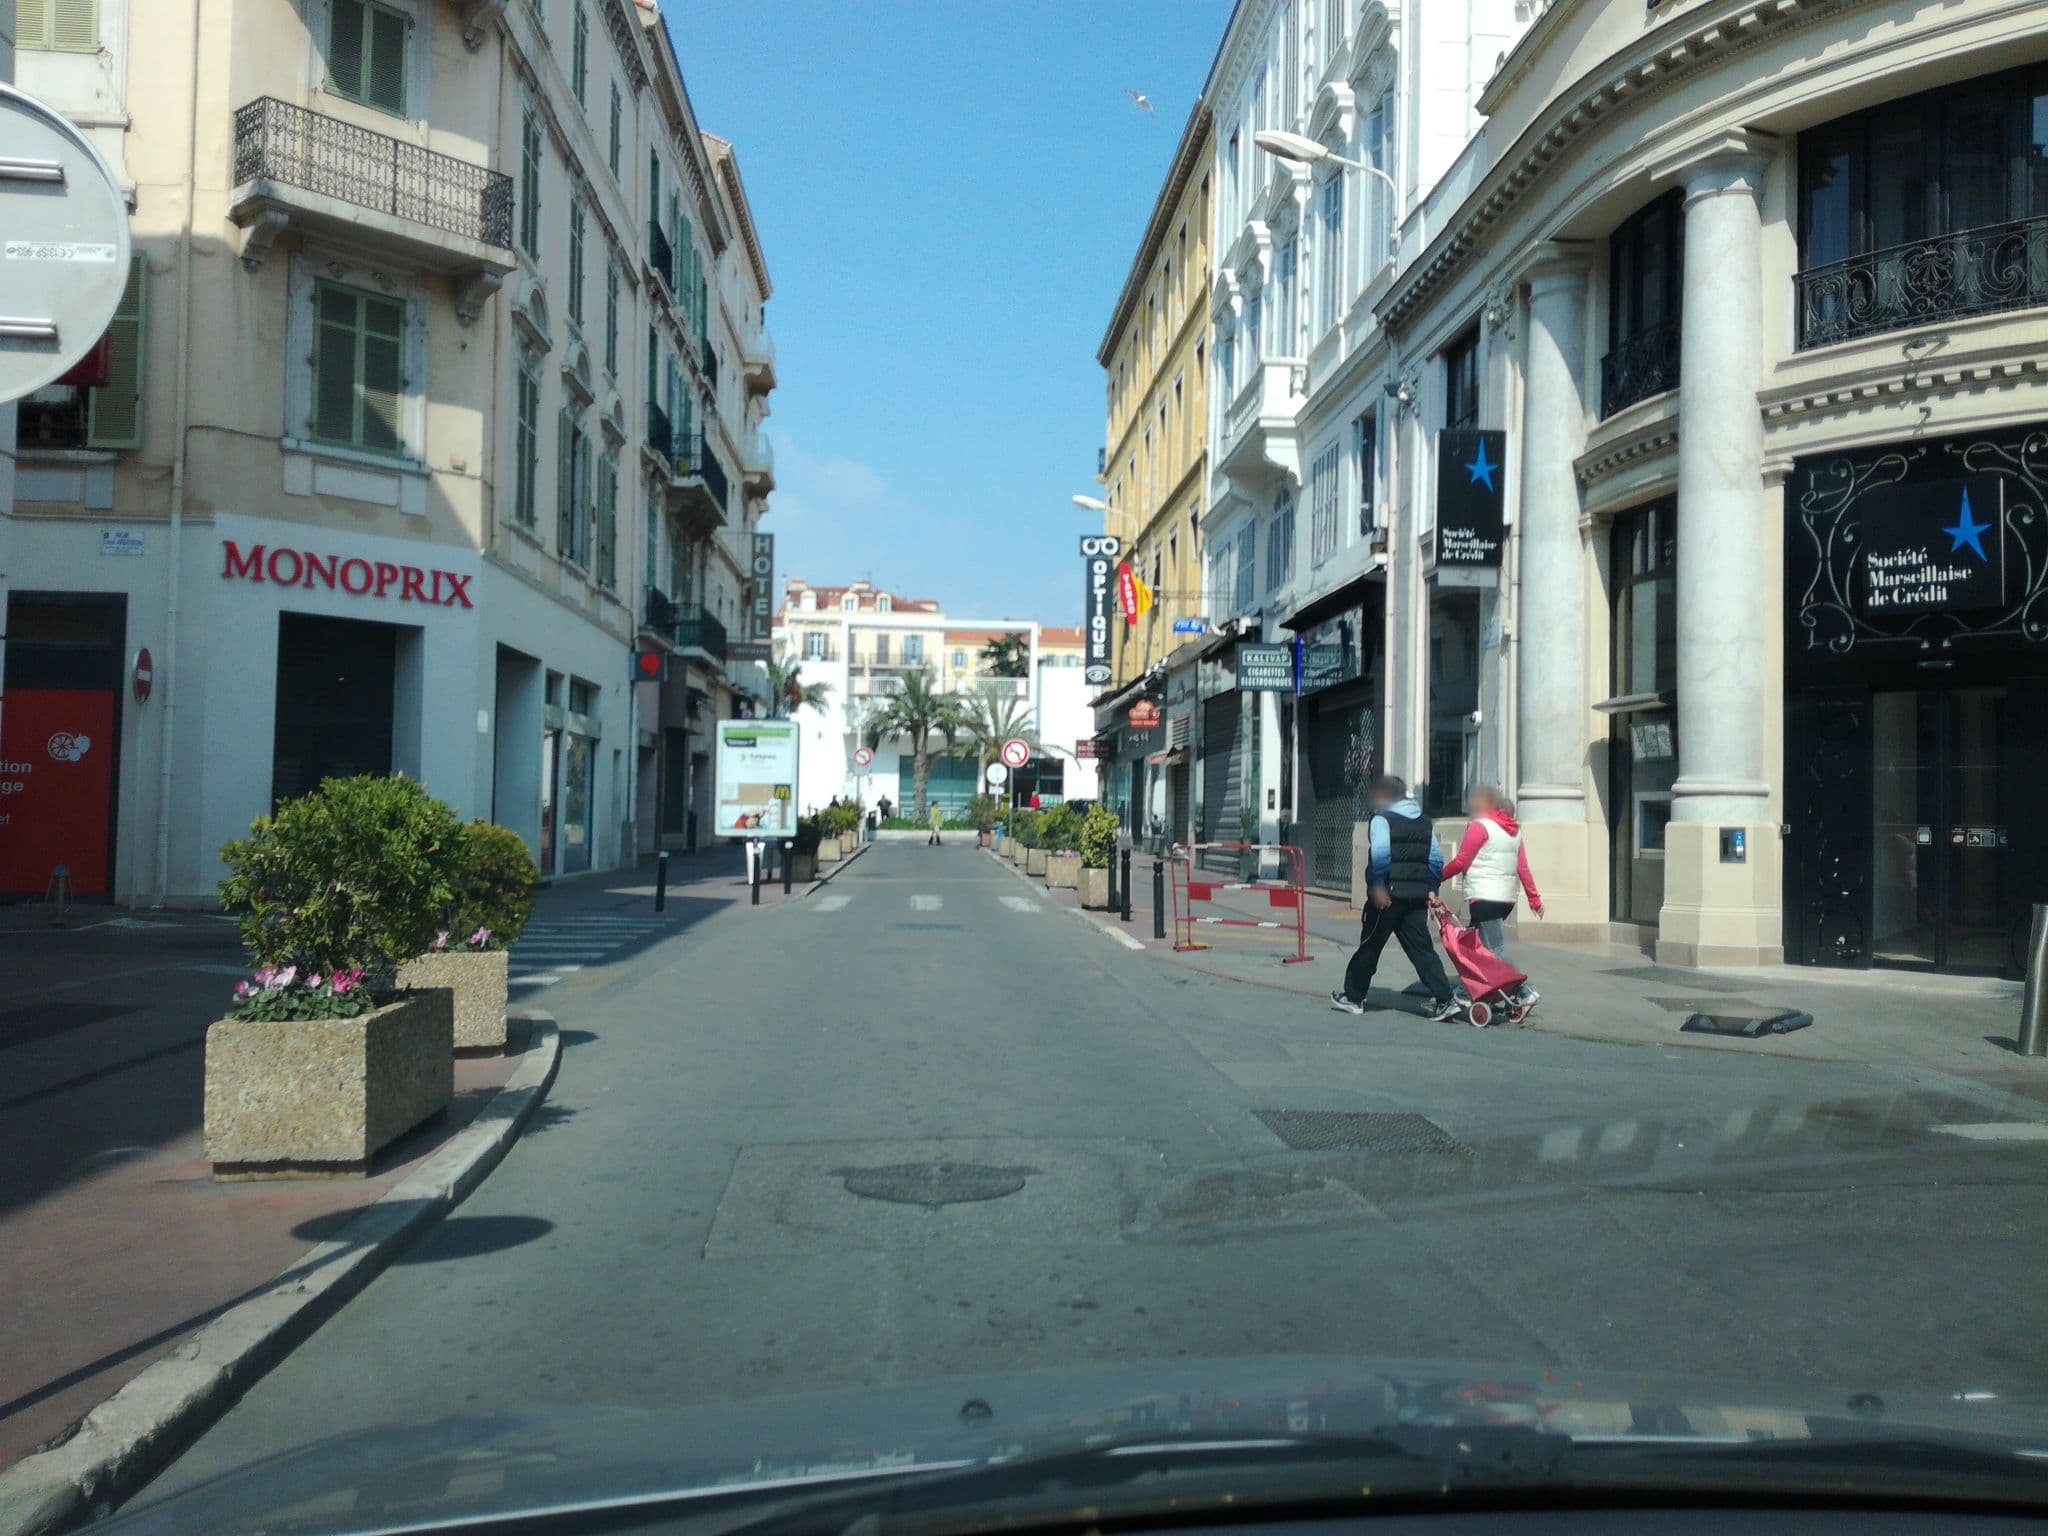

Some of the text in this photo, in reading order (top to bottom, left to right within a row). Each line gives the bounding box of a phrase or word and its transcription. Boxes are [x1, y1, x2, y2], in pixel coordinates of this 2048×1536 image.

[222, 539, 474, 609] MONOPRIX
[1867, 546, 1928, 569] Société
[1869, 564, 1972, 588] Marseillaise
[753, 536, 771, 637] HOTEL
[1091, 560, 1108, 659] OPTIQUE
[1868, 584, 1948, 607] de Crédit
